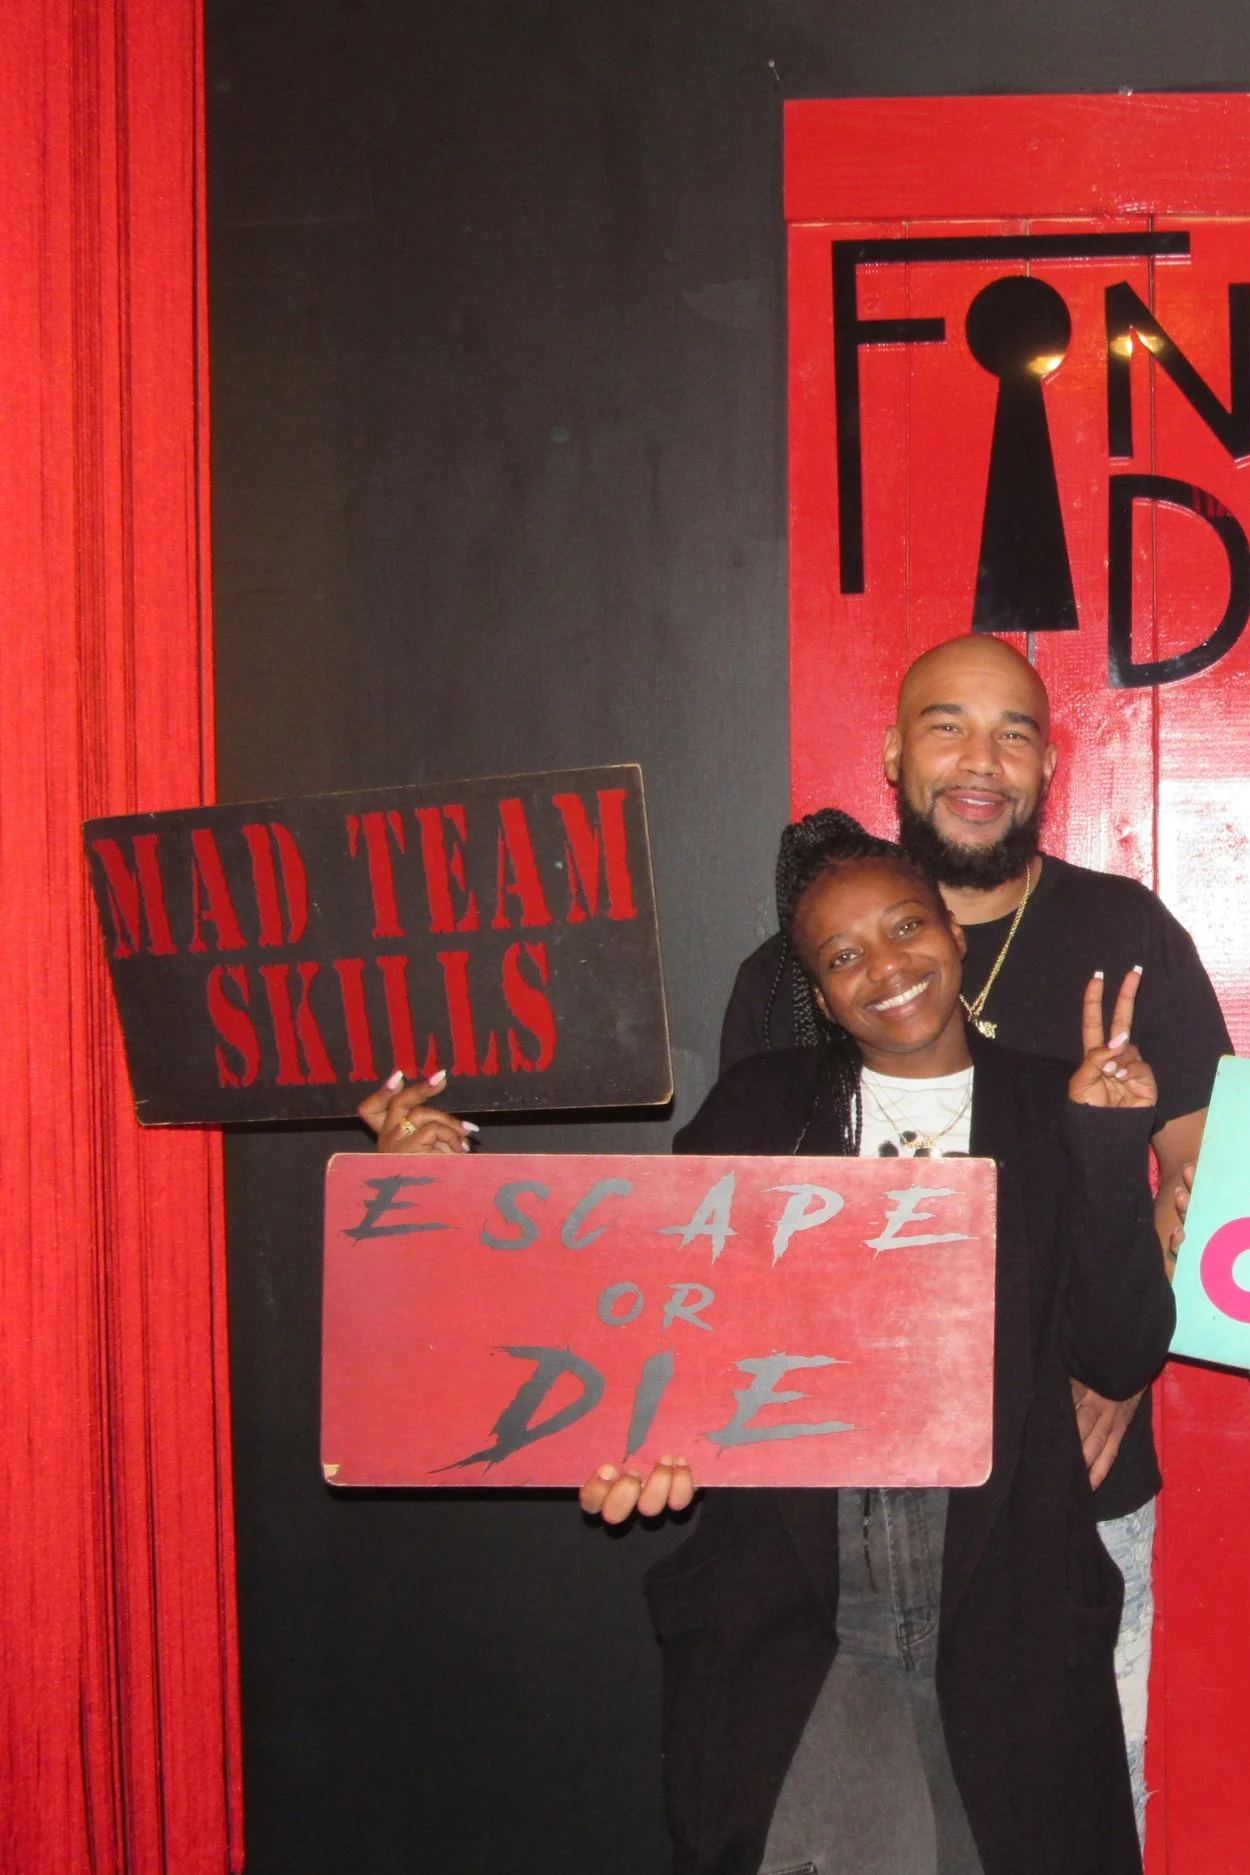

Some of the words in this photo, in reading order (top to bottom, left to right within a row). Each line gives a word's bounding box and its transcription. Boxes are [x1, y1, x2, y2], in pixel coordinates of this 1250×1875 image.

[91, 821, 308, 958] MAD
[345, 787, 638, 938] TEAM
[206, 941, 557, 1088] SKILLS
[341, 1169, 980, 1267] ESCAPE
[597, 1281, 716, 1332] OR
[427, 1344, 868, 1474] DIE
